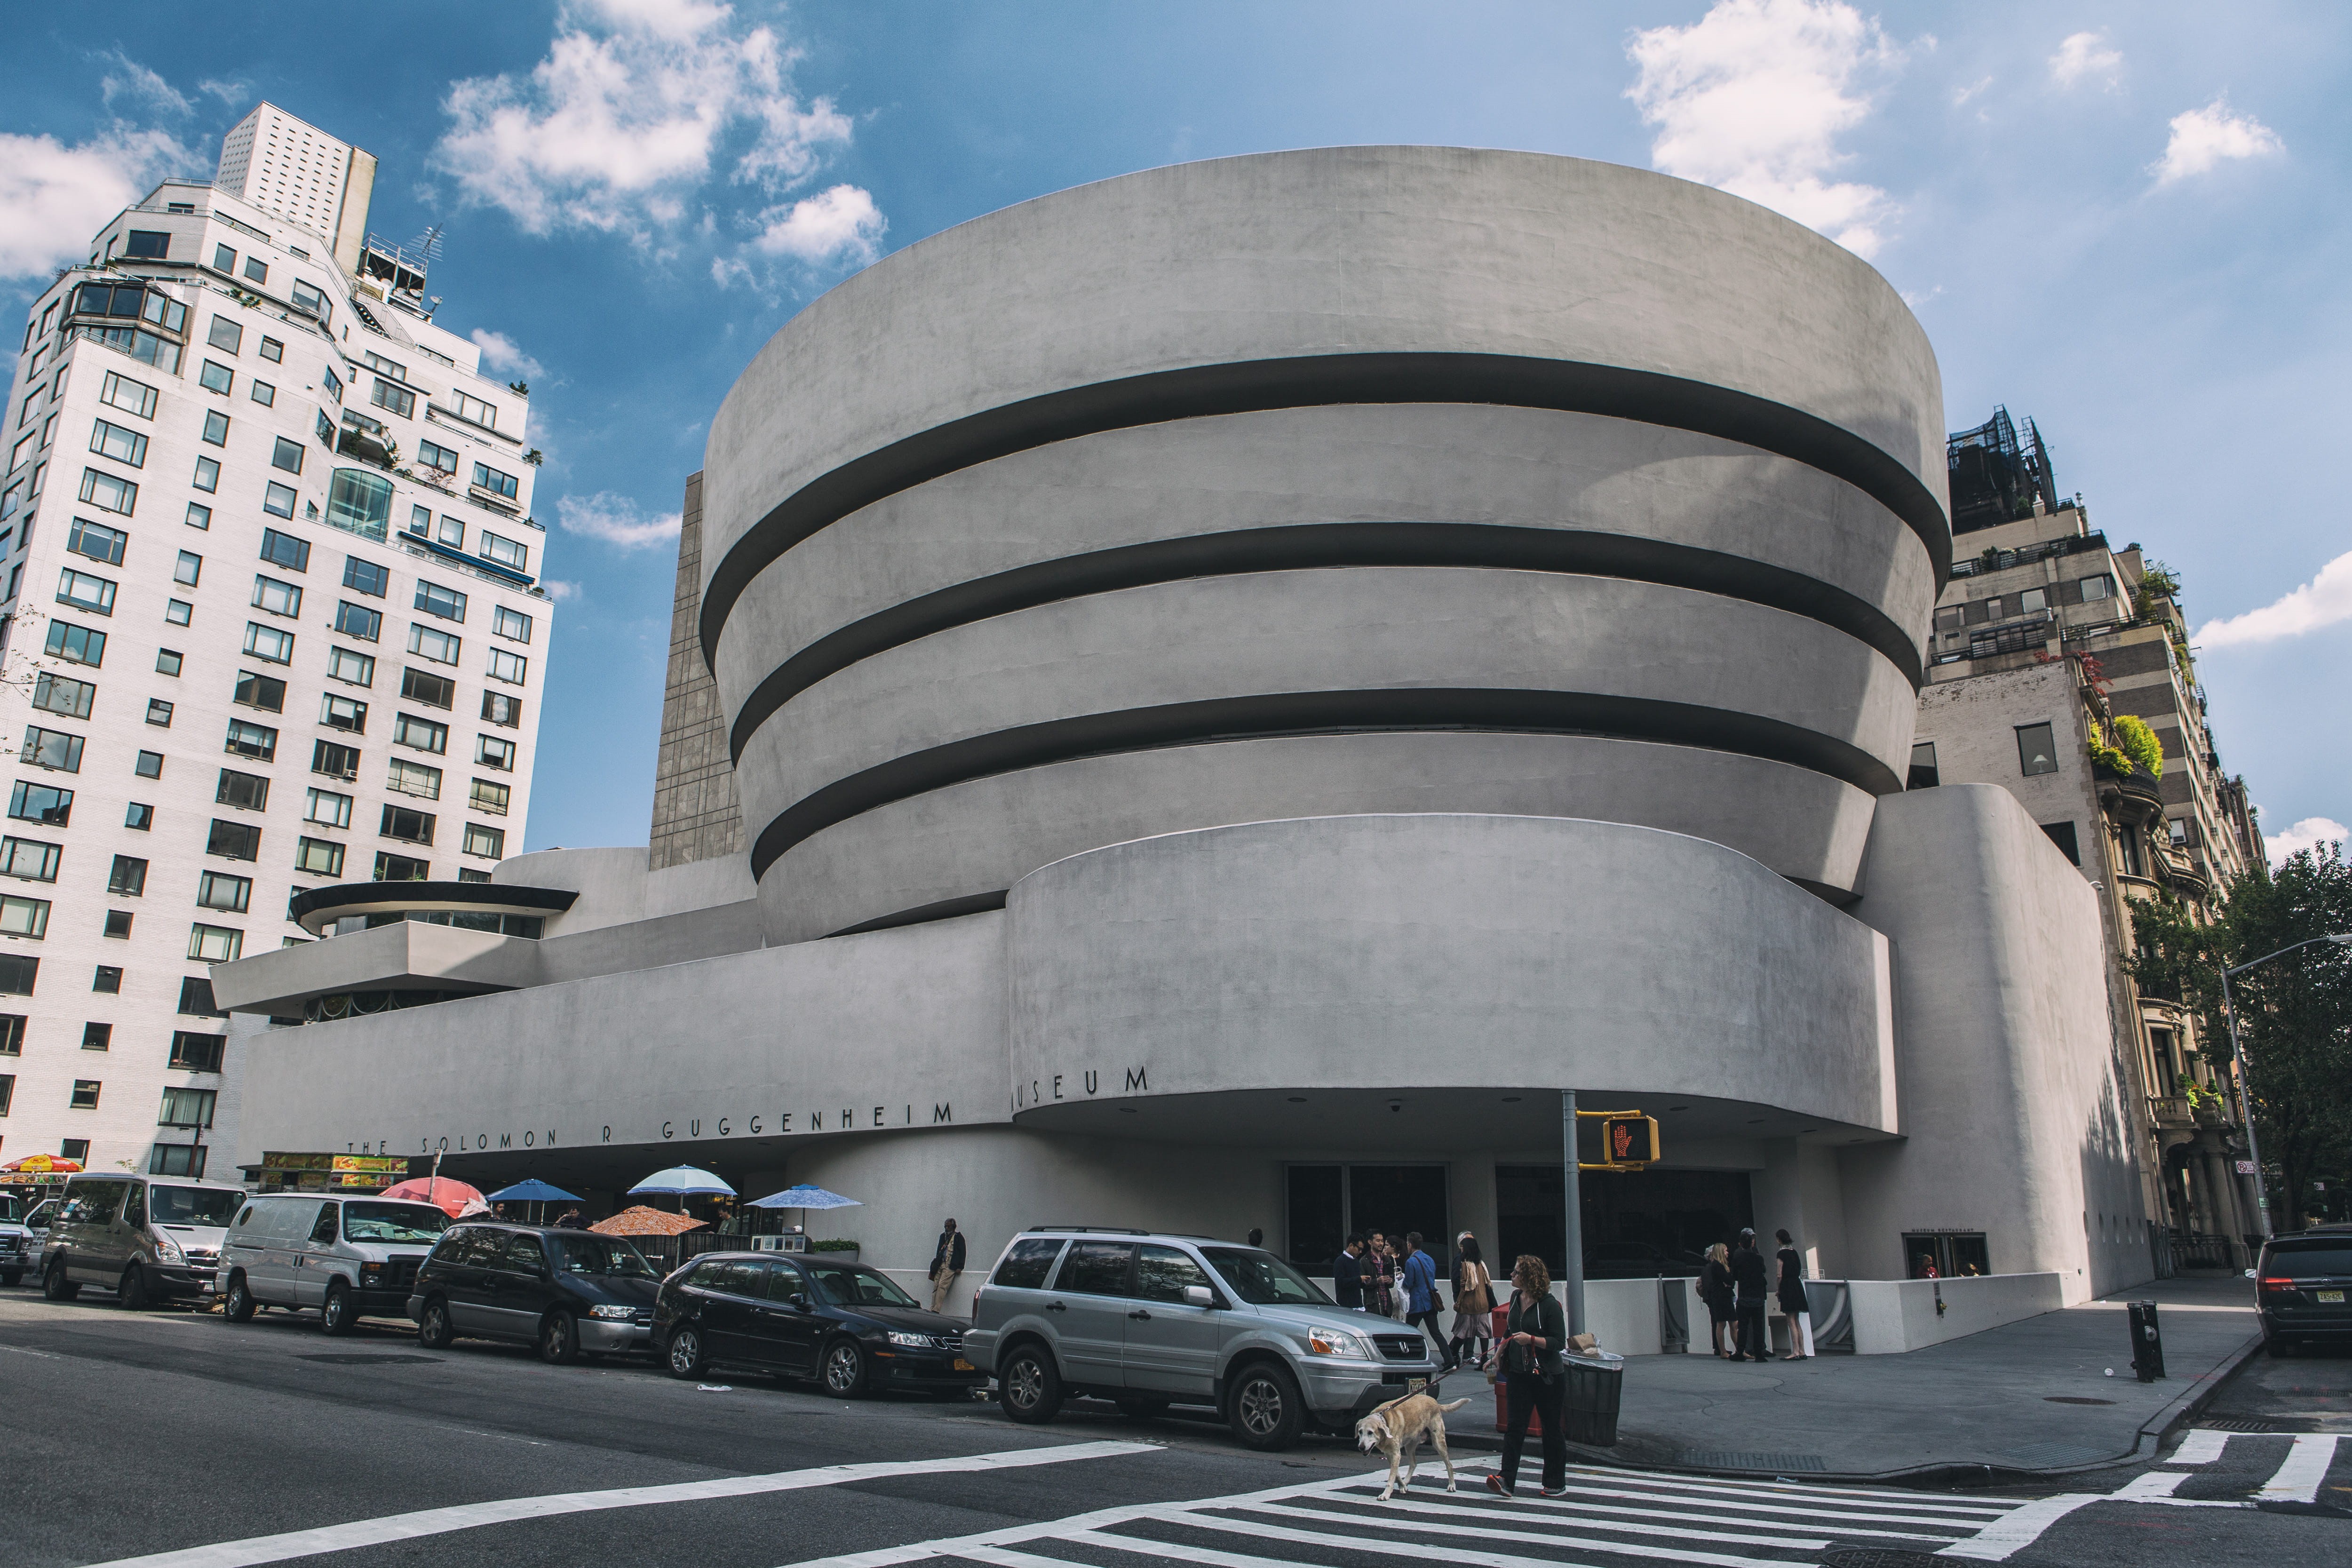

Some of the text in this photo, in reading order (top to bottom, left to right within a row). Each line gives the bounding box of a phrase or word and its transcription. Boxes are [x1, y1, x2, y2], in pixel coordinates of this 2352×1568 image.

[347, 1065, 1148, 1154] THE SOLOMON R GUGGENHEIM USEUM
